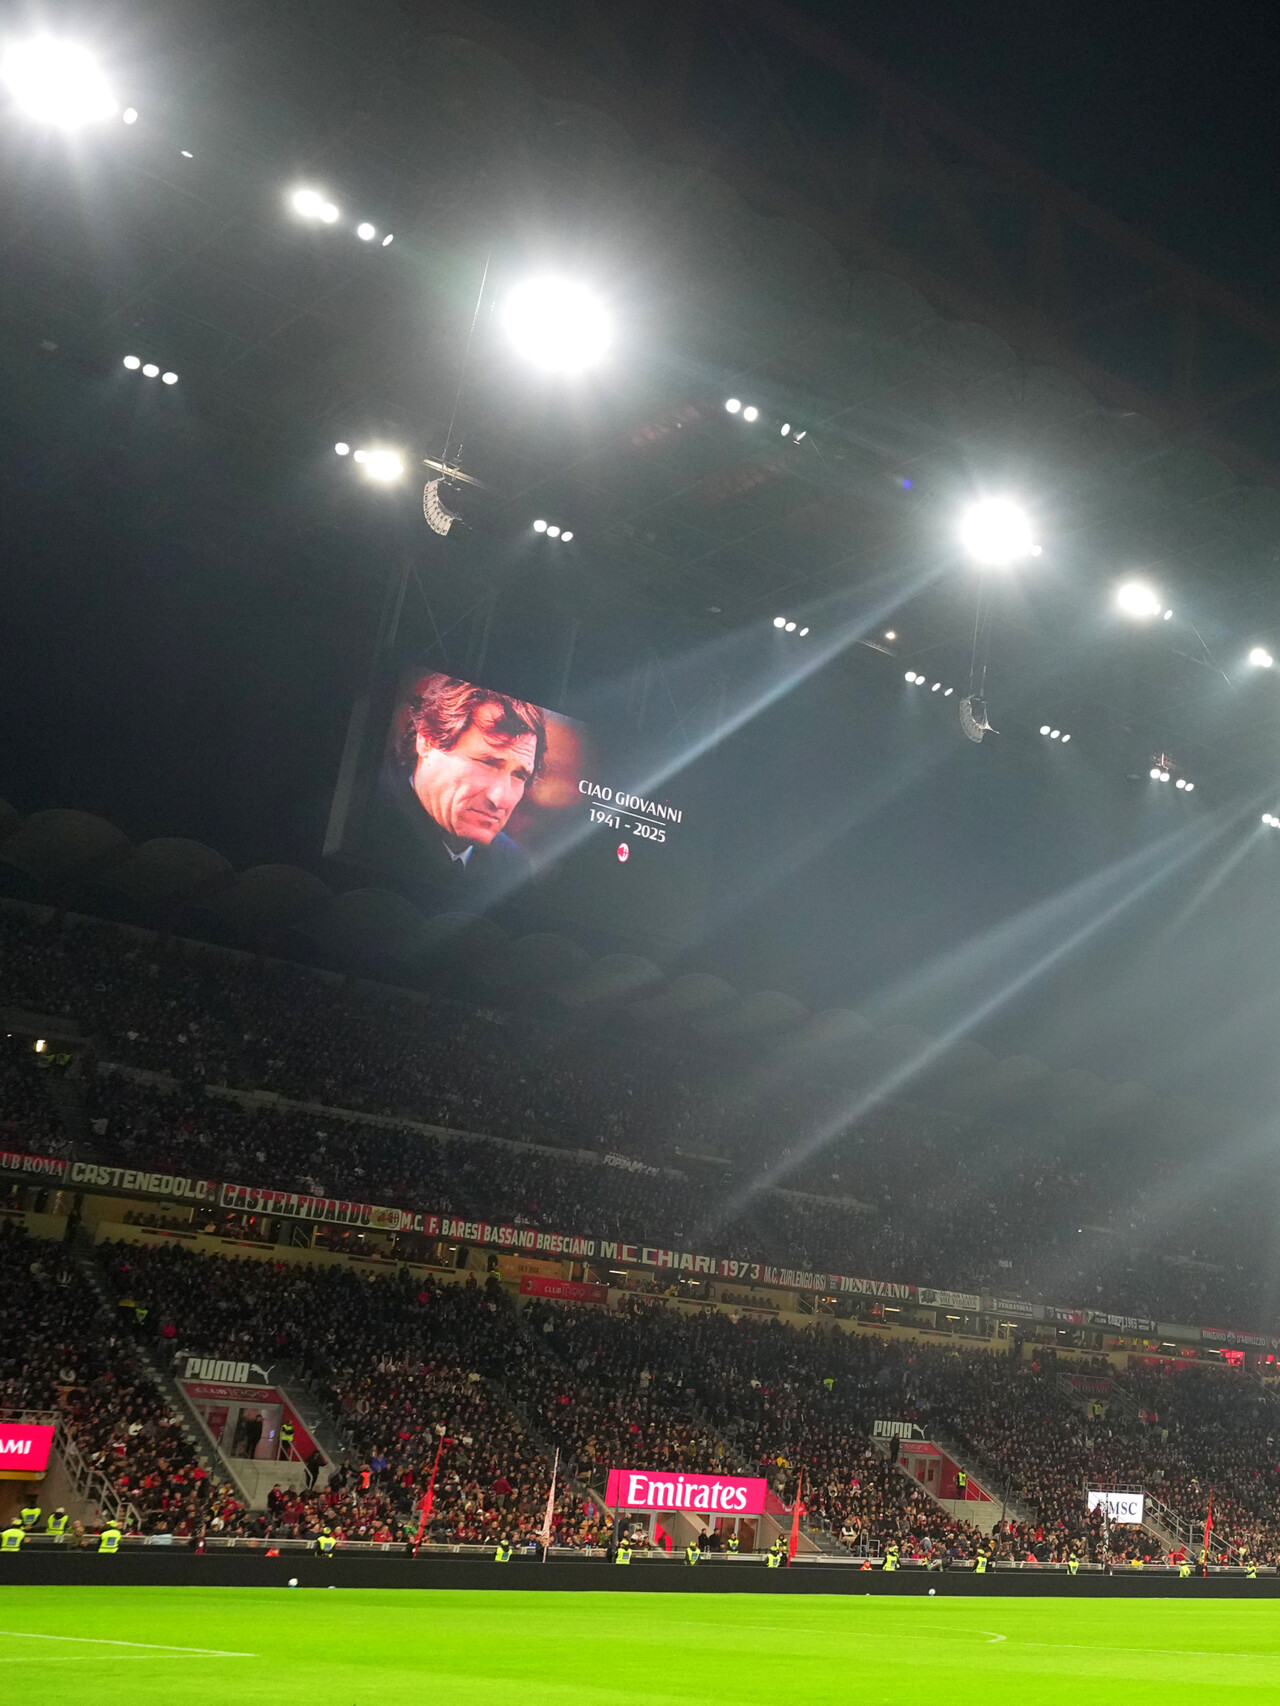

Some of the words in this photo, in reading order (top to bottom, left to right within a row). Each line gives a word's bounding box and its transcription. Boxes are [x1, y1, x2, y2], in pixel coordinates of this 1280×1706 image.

[578, 780, 612, 801] CIAO
[615, 791, 682, 824] GIOVANNI
[589, 808, 620, 829] 1941
[632, 822, 666, 843] 2025
[22, 1156, 63, 1176] ROMA
[70, 1162, 208, 1199] CASTENEDOLO
[222, 1184, 372, 1226] CASTELFIDARDO
[429, 1215, 439, 1234] F.
[442, 1220, 481, 1240] BARESI
[484, 1226, 534, 1249] BASSANO
[536, 1234, 595, 1257] BRESCIANO
[722, 1260, 760, 1280] 1973
[184, 1358, 250, 1383] PUMA
[873, 1420, 912, 1439] PUMA
[627, 1474, 748, 1510] Emirates
[1109, 1501, 1138, 1516] MSC
